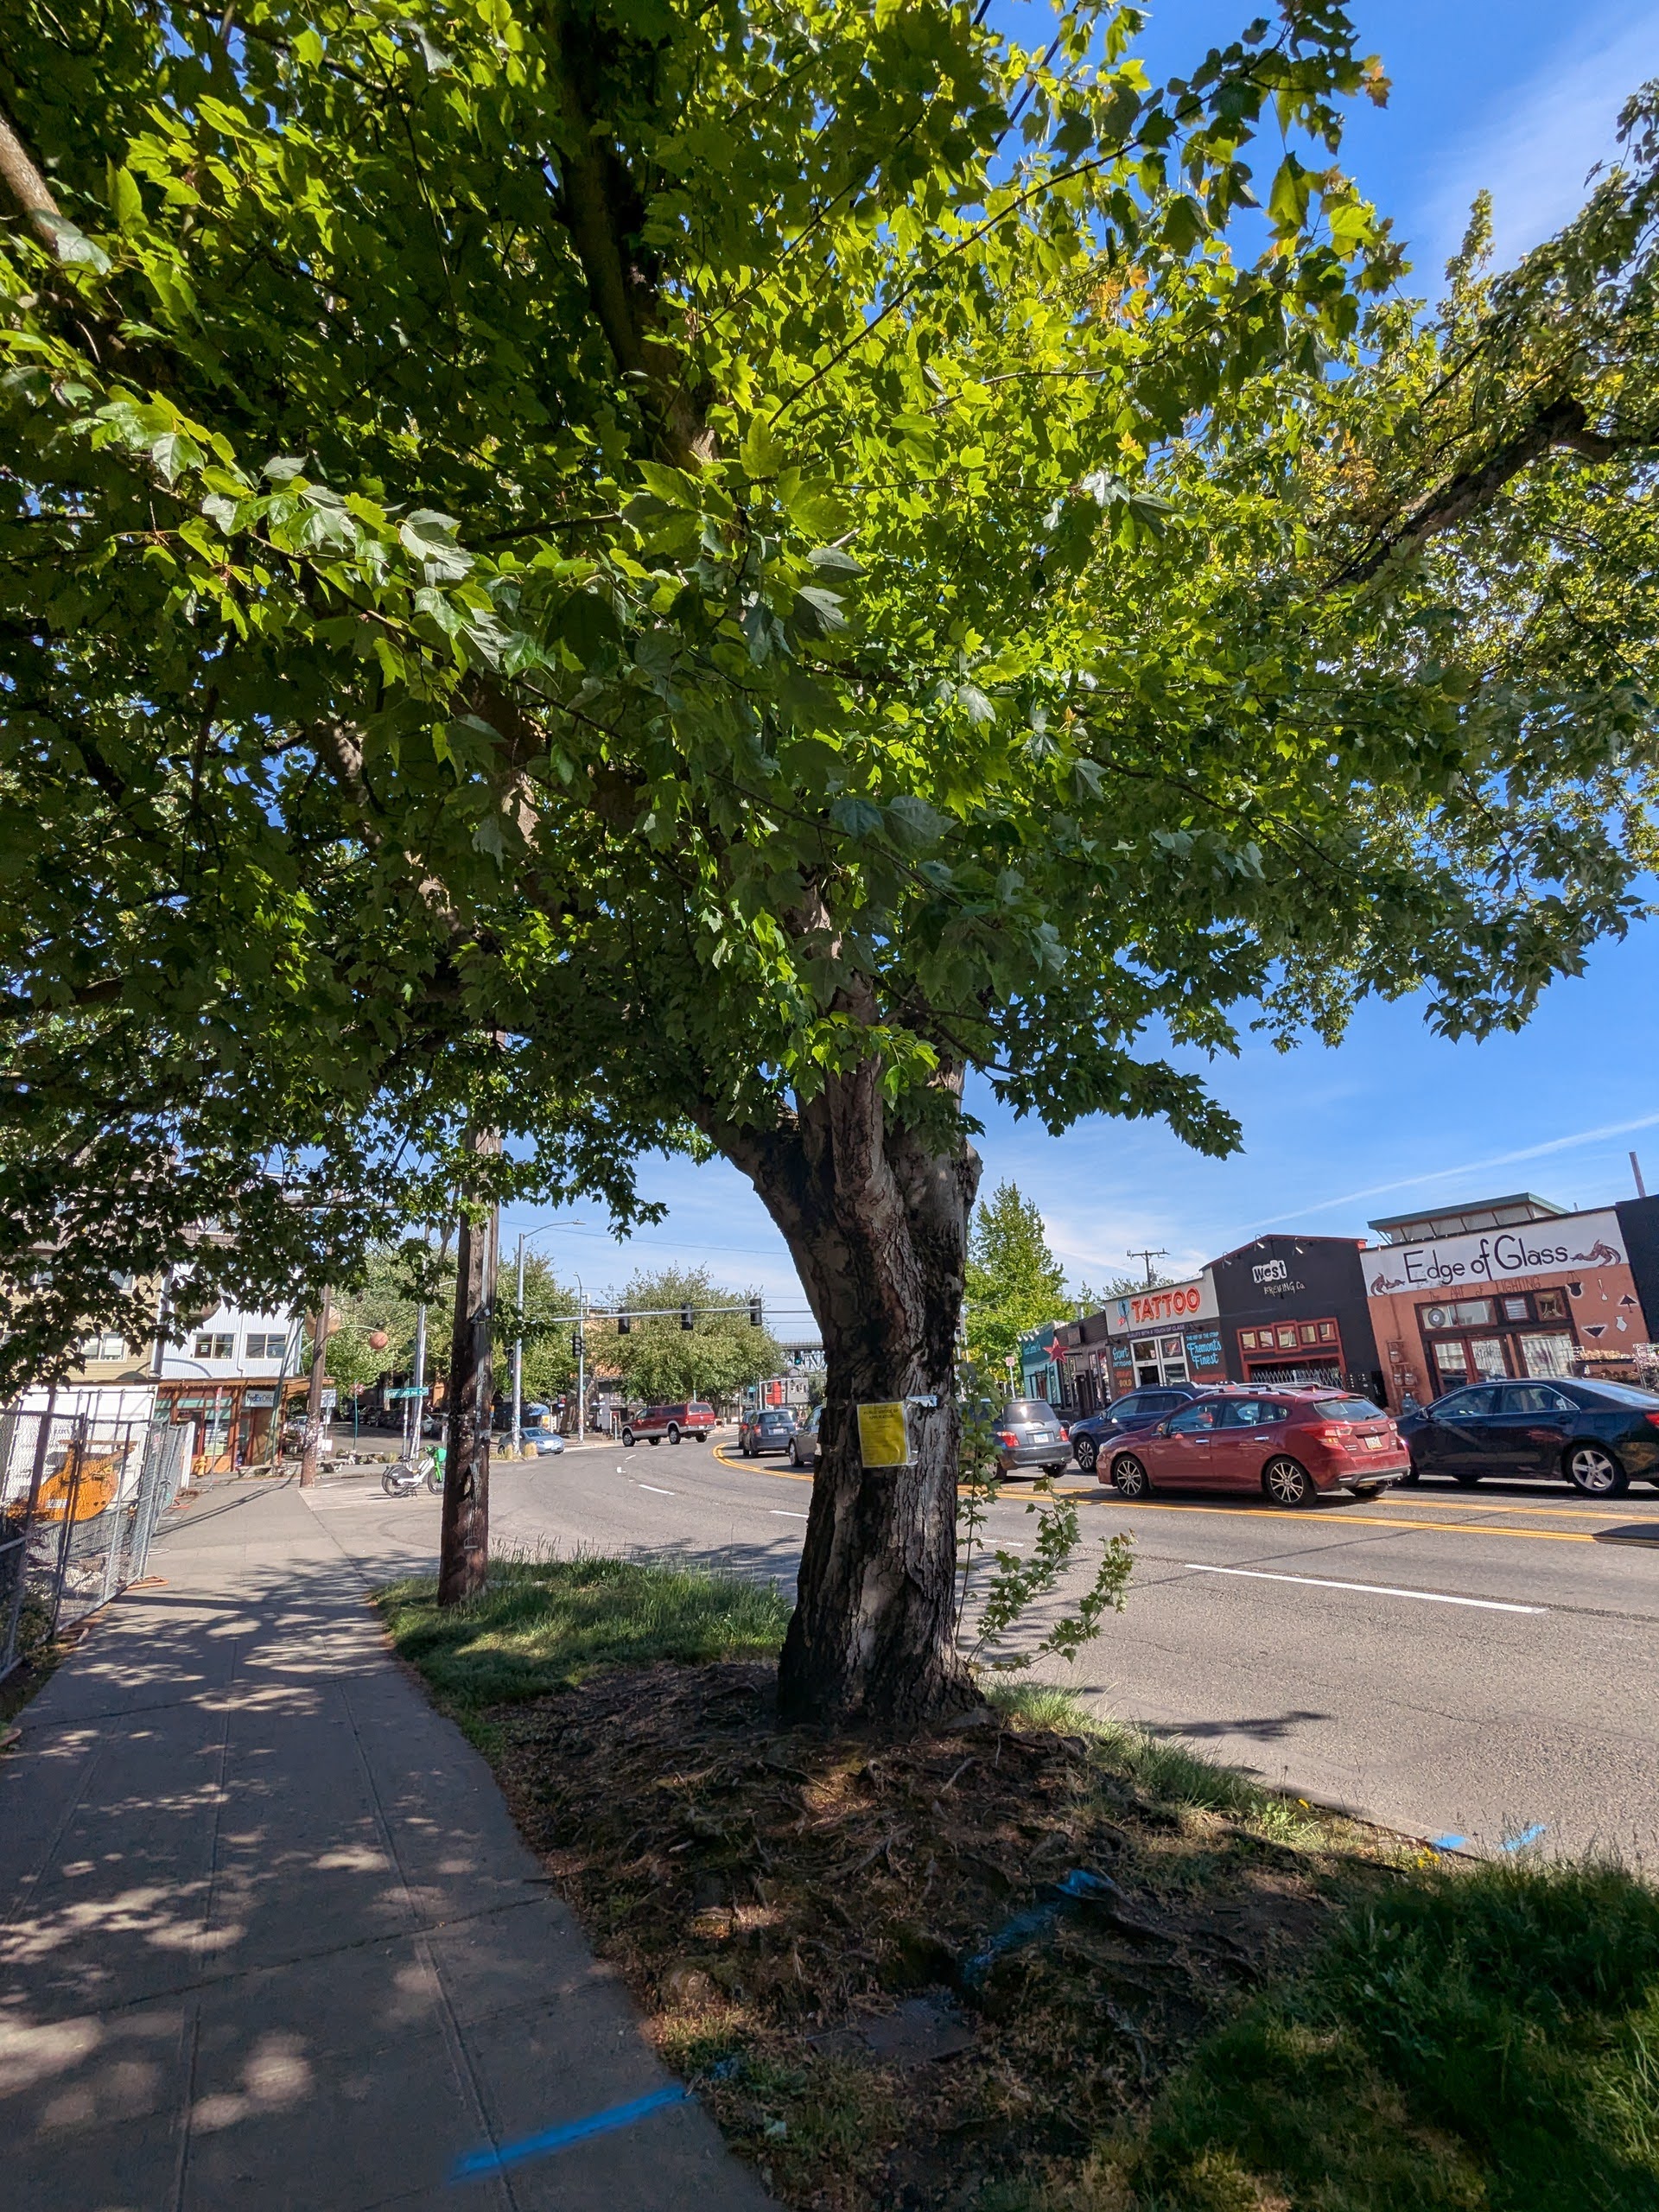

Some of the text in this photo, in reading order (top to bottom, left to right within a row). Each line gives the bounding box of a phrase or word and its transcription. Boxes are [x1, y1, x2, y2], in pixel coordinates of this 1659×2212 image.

[1402, 1234, 1568, 1285] Edge of Glass
[1253, 1261, 1287, 1282] West
[1495, 1277, 1541, 1294] LIGHTING
[1131, 1285, 1200, 1324] TATTOO
[1192, 1352, 1218, 1370] Finest
[247, 1393, 273, 1402] FedEx Offic
